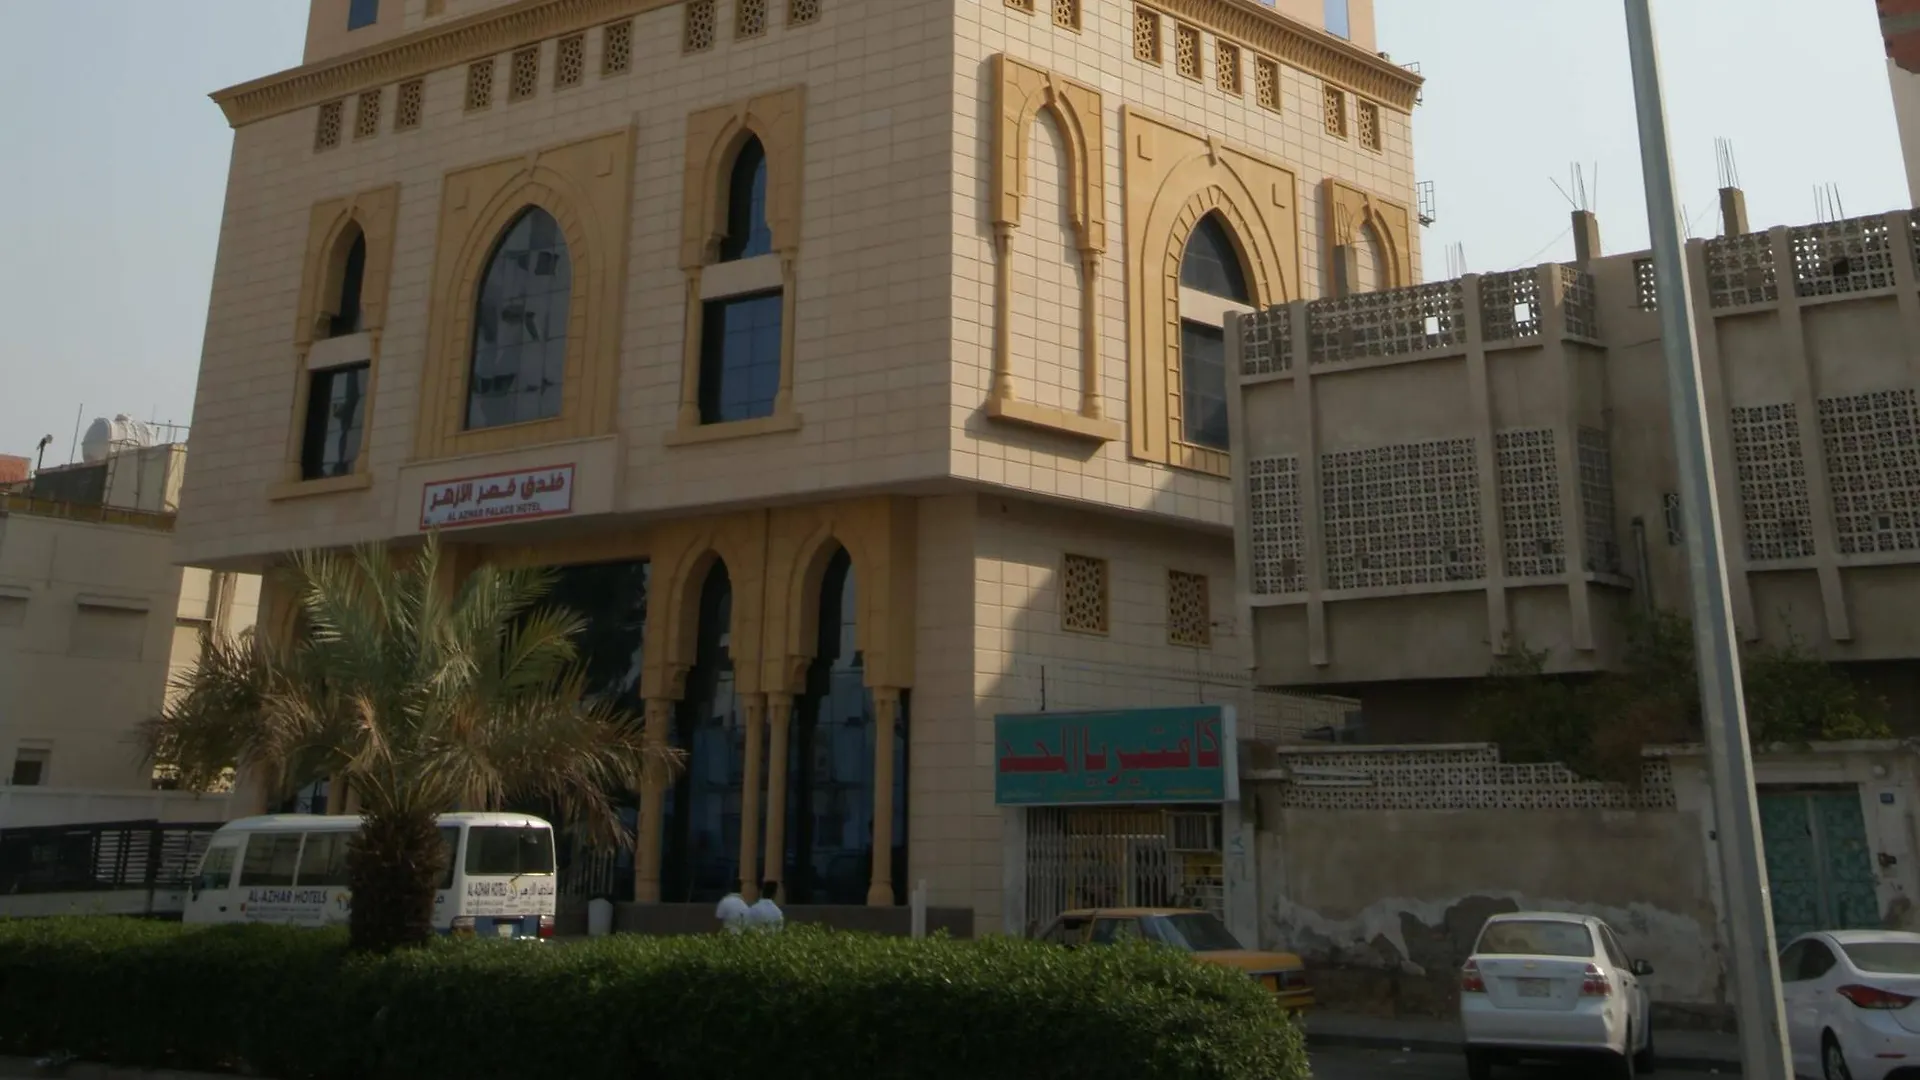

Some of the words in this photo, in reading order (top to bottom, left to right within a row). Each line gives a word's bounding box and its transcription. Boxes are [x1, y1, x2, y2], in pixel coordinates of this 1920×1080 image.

[476, 477, 517, 506] قصر
[520, 471, 565, 501] فندق
[447, 511, 457, 521] AL
[458, 507, 484, 520] AZHAR
[485, 503, 514, 517] PALACE
[516, 502, 542, 514] HOTEL
[248, 888, 293, 903] AL-AZHAR
[294, 888, 328, 904] HOTELS
